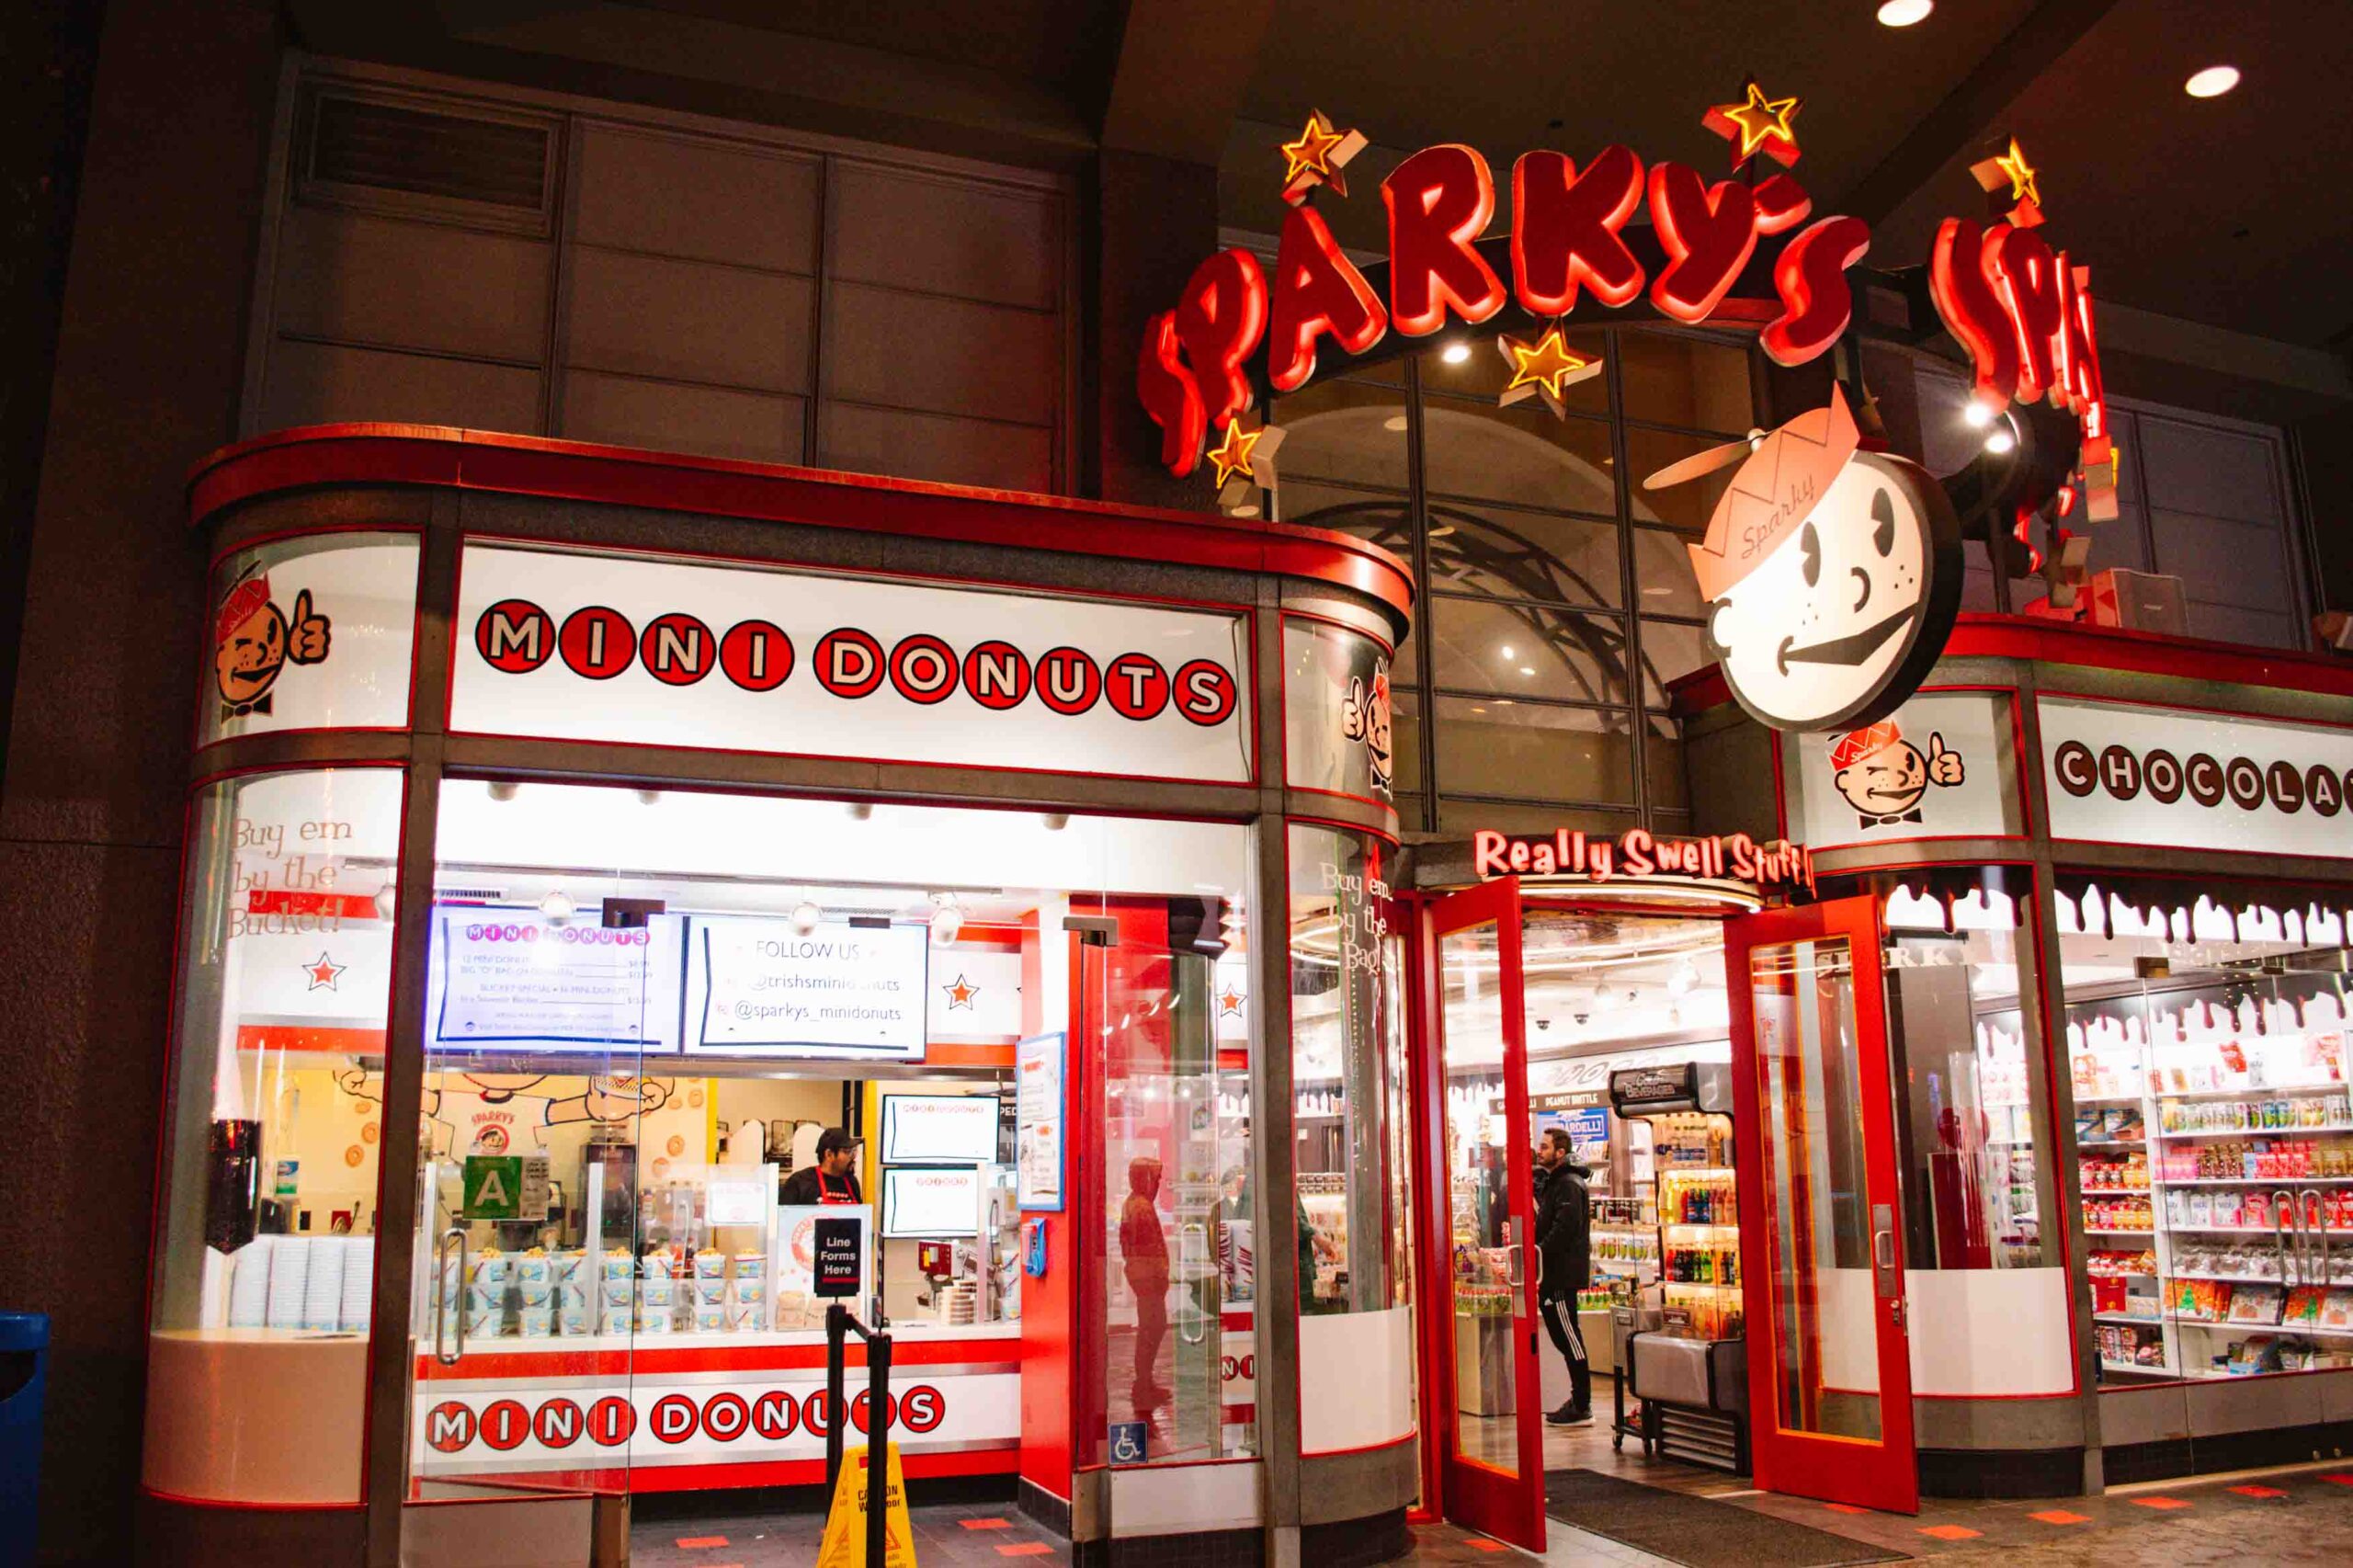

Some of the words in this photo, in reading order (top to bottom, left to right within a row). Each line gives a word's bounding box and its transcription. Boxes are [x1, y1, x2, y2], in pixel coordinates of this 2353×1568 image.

[1137, 142, 1870, 478] SPARKY'S
[1742, 474, 1814, 560] Sparky
[481, 603, 786, 687] MINI
[819, 632, 1232, 722] DONUTS
[2057, 744, 2352, 814] CHOCOLA
[233, 818, 284, 859] Buy
[300, 819, 352, 840] em
[1474, 829, 1612, 881] Really
[1622, 829, 1724, 878] Swell
[233, 857, 268, 906] by
[283, 854, 337, 890] the
[1320, 862, 1362, 905] Buy
[228, 897, 346, 939] Bucket!
[467, 924, 539, 942] MINI
[1328, 903, 1357, 943] by
[1363, 904, 1388, 935] the
[756, 940, 833, 960] FOLLOW
[838, 942, 859, 960] US
[474, 1169, 509, 1207] A
[820, 1251, 857, 1261] Forms
[826, 1236, 851, 1247] Line
[824, 1265, 852, 1275] Here
[428, 1398, 631, 1449] MINI
[653, 1387, 942, 1441] DONUS
